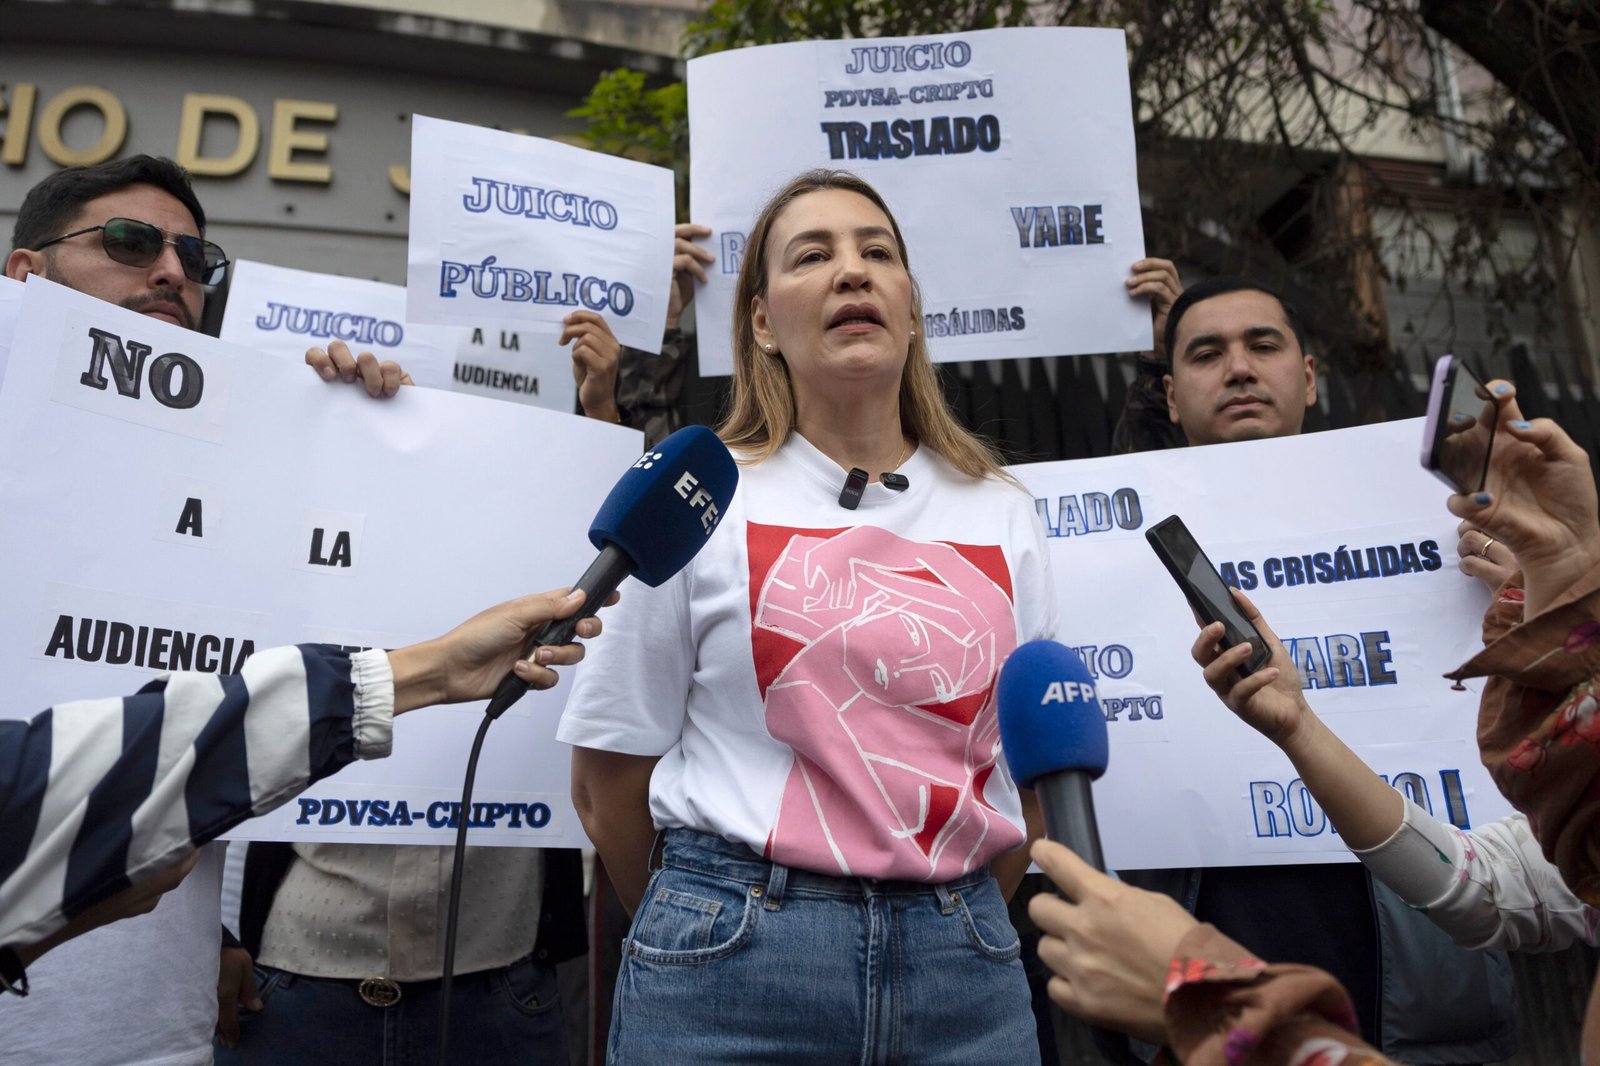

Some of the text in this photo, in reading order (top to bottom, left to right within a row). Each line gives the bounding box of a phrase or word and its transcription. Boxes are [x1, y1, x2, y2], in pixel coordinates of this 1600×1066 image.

[845, 40, 972, 74] JUICIO
[824, 79, 994, 108] PDVSA-CRIPTO
[176, 93, 338, 183] DE
[820, 114, 1001, 160] TRASLADO
[463, 176, 618, 230] JUICIO
[1010, 204, 1105, 248] YARE
[440, 256, 634, 316] PÚBLICO
[256, 302, 404, 347] JUICIO
[471, 328, 519, 351] A LA
[924, 306, 1025, 338] ISÁLIDAS
[80, 328, 204, 409] NO
[453, 362, 539, 396] AUDIENCIA
[176, 497, 352, 567] A LA
[1034, 487, 1143, 538] LADO
[1219, 539, 1443, 591] AS CRISÁLIDAS
[44, 614, 255, 676] AUDIENCIA
[1280, 630, 1397, 690] ARE
[1040, 681, 1096, 706] AFP
[296, 798, 551, 829] PDVSA-CRIPTO
[1249, 771, 1434, 838] ROO
